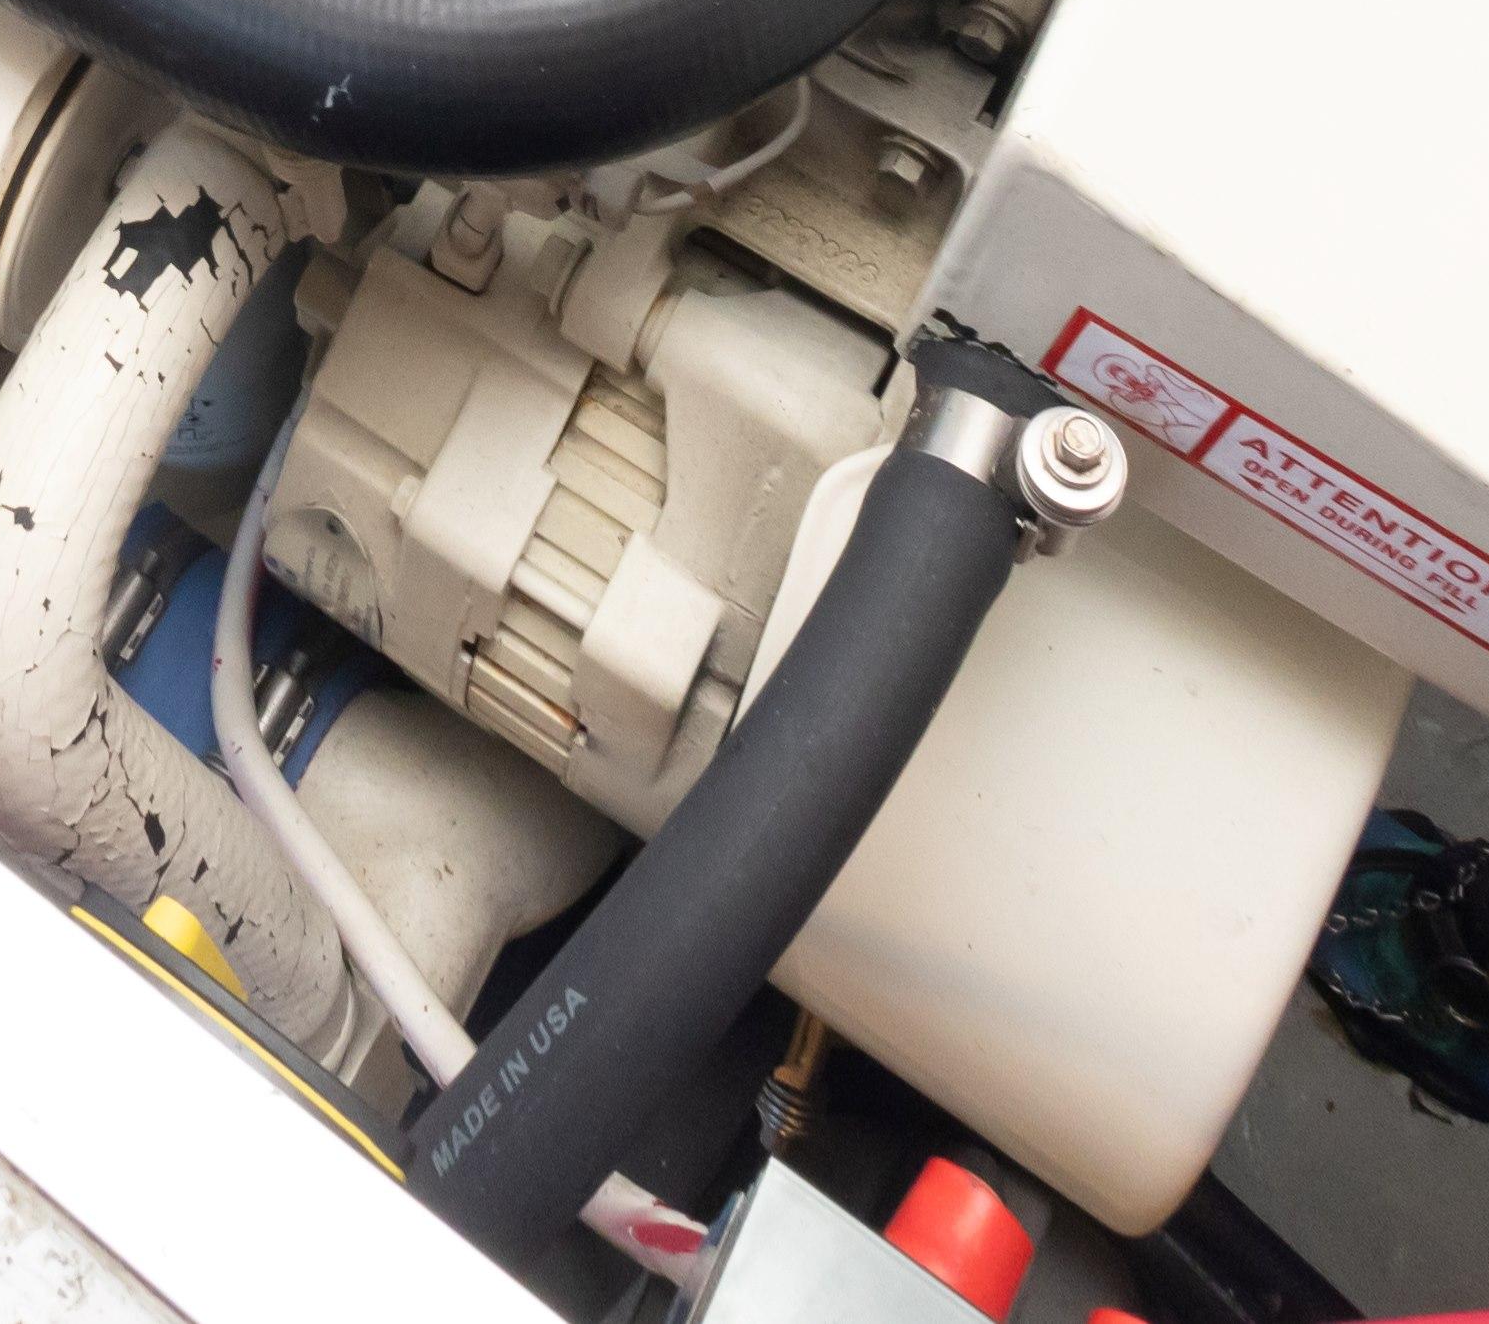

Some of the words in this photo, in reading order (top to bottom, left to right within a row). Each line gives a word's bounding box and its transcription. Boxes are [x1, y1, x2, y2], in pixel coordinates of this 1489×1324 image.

[1242, 459, 1310, 503] OPEN
[1318, 504, 1418, 570] DURING
[1426, 573, 1477, 608] FILL
[431, 1083, 501, 1178] MADE
[498, 1048, 530, 1093] IN
[528, 986, 588, 1055] USA
